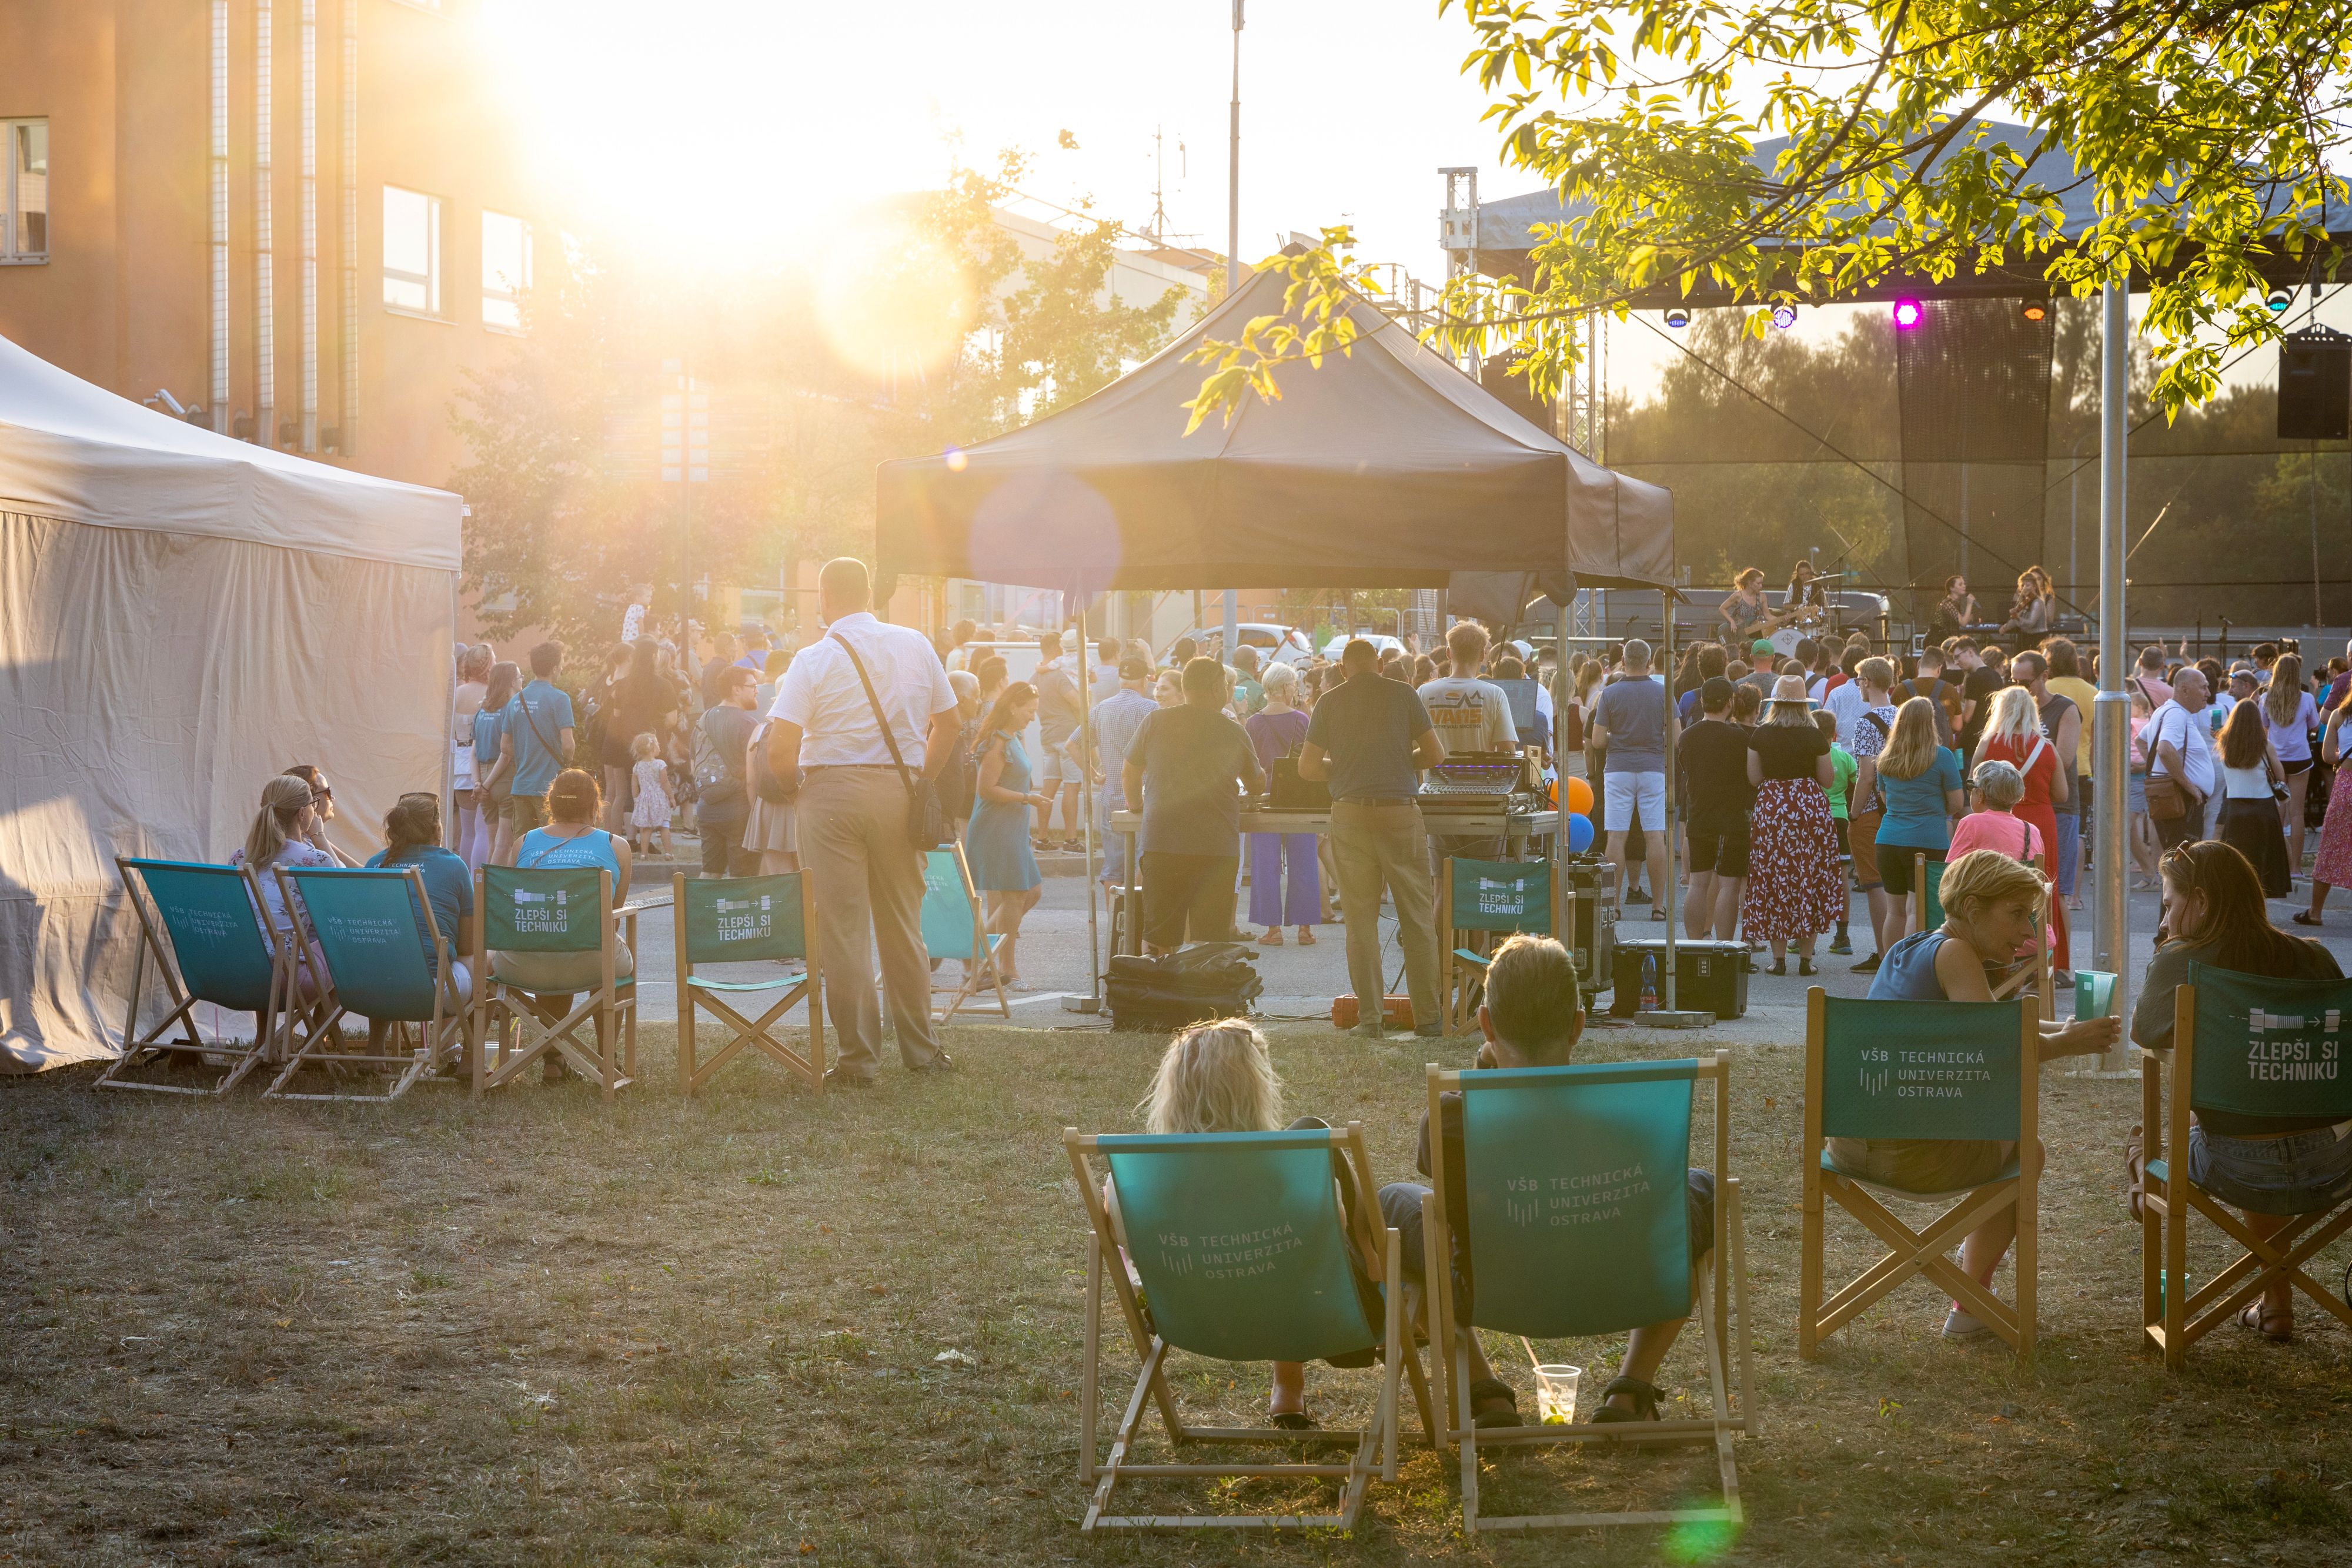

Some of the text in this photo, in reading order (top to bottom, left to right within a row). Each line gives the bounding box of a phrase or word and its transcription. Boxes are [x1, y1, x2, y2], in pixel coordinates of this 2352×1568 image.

[1479, 892, 1524, 904] ZLEPŠI SI
[515, 908, 567, 921] ZLEPŠI SI
[1479, 902, 1524, 914] TECHNIKU
[192, 917, 238, 928] UNIVERZITA
[514, 921, 567, 932] TECHNIKU
[717, 914, 771, 929] ZLEPŠI SI
[195, 927, 227, 937] OSTRAVA
[349, 927, 399, 935] UNIVERZITA
[718, 927, 771, 941] TECHNIKU
[1861, 1047, 1984, 1064] VŠB TECHNICKÁ
[2248, 1038, 2338, 1061] ZLEPŠI SI
[1898, 1069, 1990, 1081] UNIVERZITA
[2247, 1061, 2338, 1081] TECHNIKU
[1897, 1086, 1963, 1098] OSTRAVA
[1507, 1162, 1642, 1191] VŠB TECHNICKÁ
[1550, 1181, 1650, 1209] UNIVERZITA
[1550, 1207, 1621, 1226] OSTRAVA
[1158, 1221, 1293, 1247] VŠB TECHNICKÁ
[1202, 1237, 1303, 1265] UNIVERZITA
[1205, 1261, 1276, 1279] OSTRAVA
